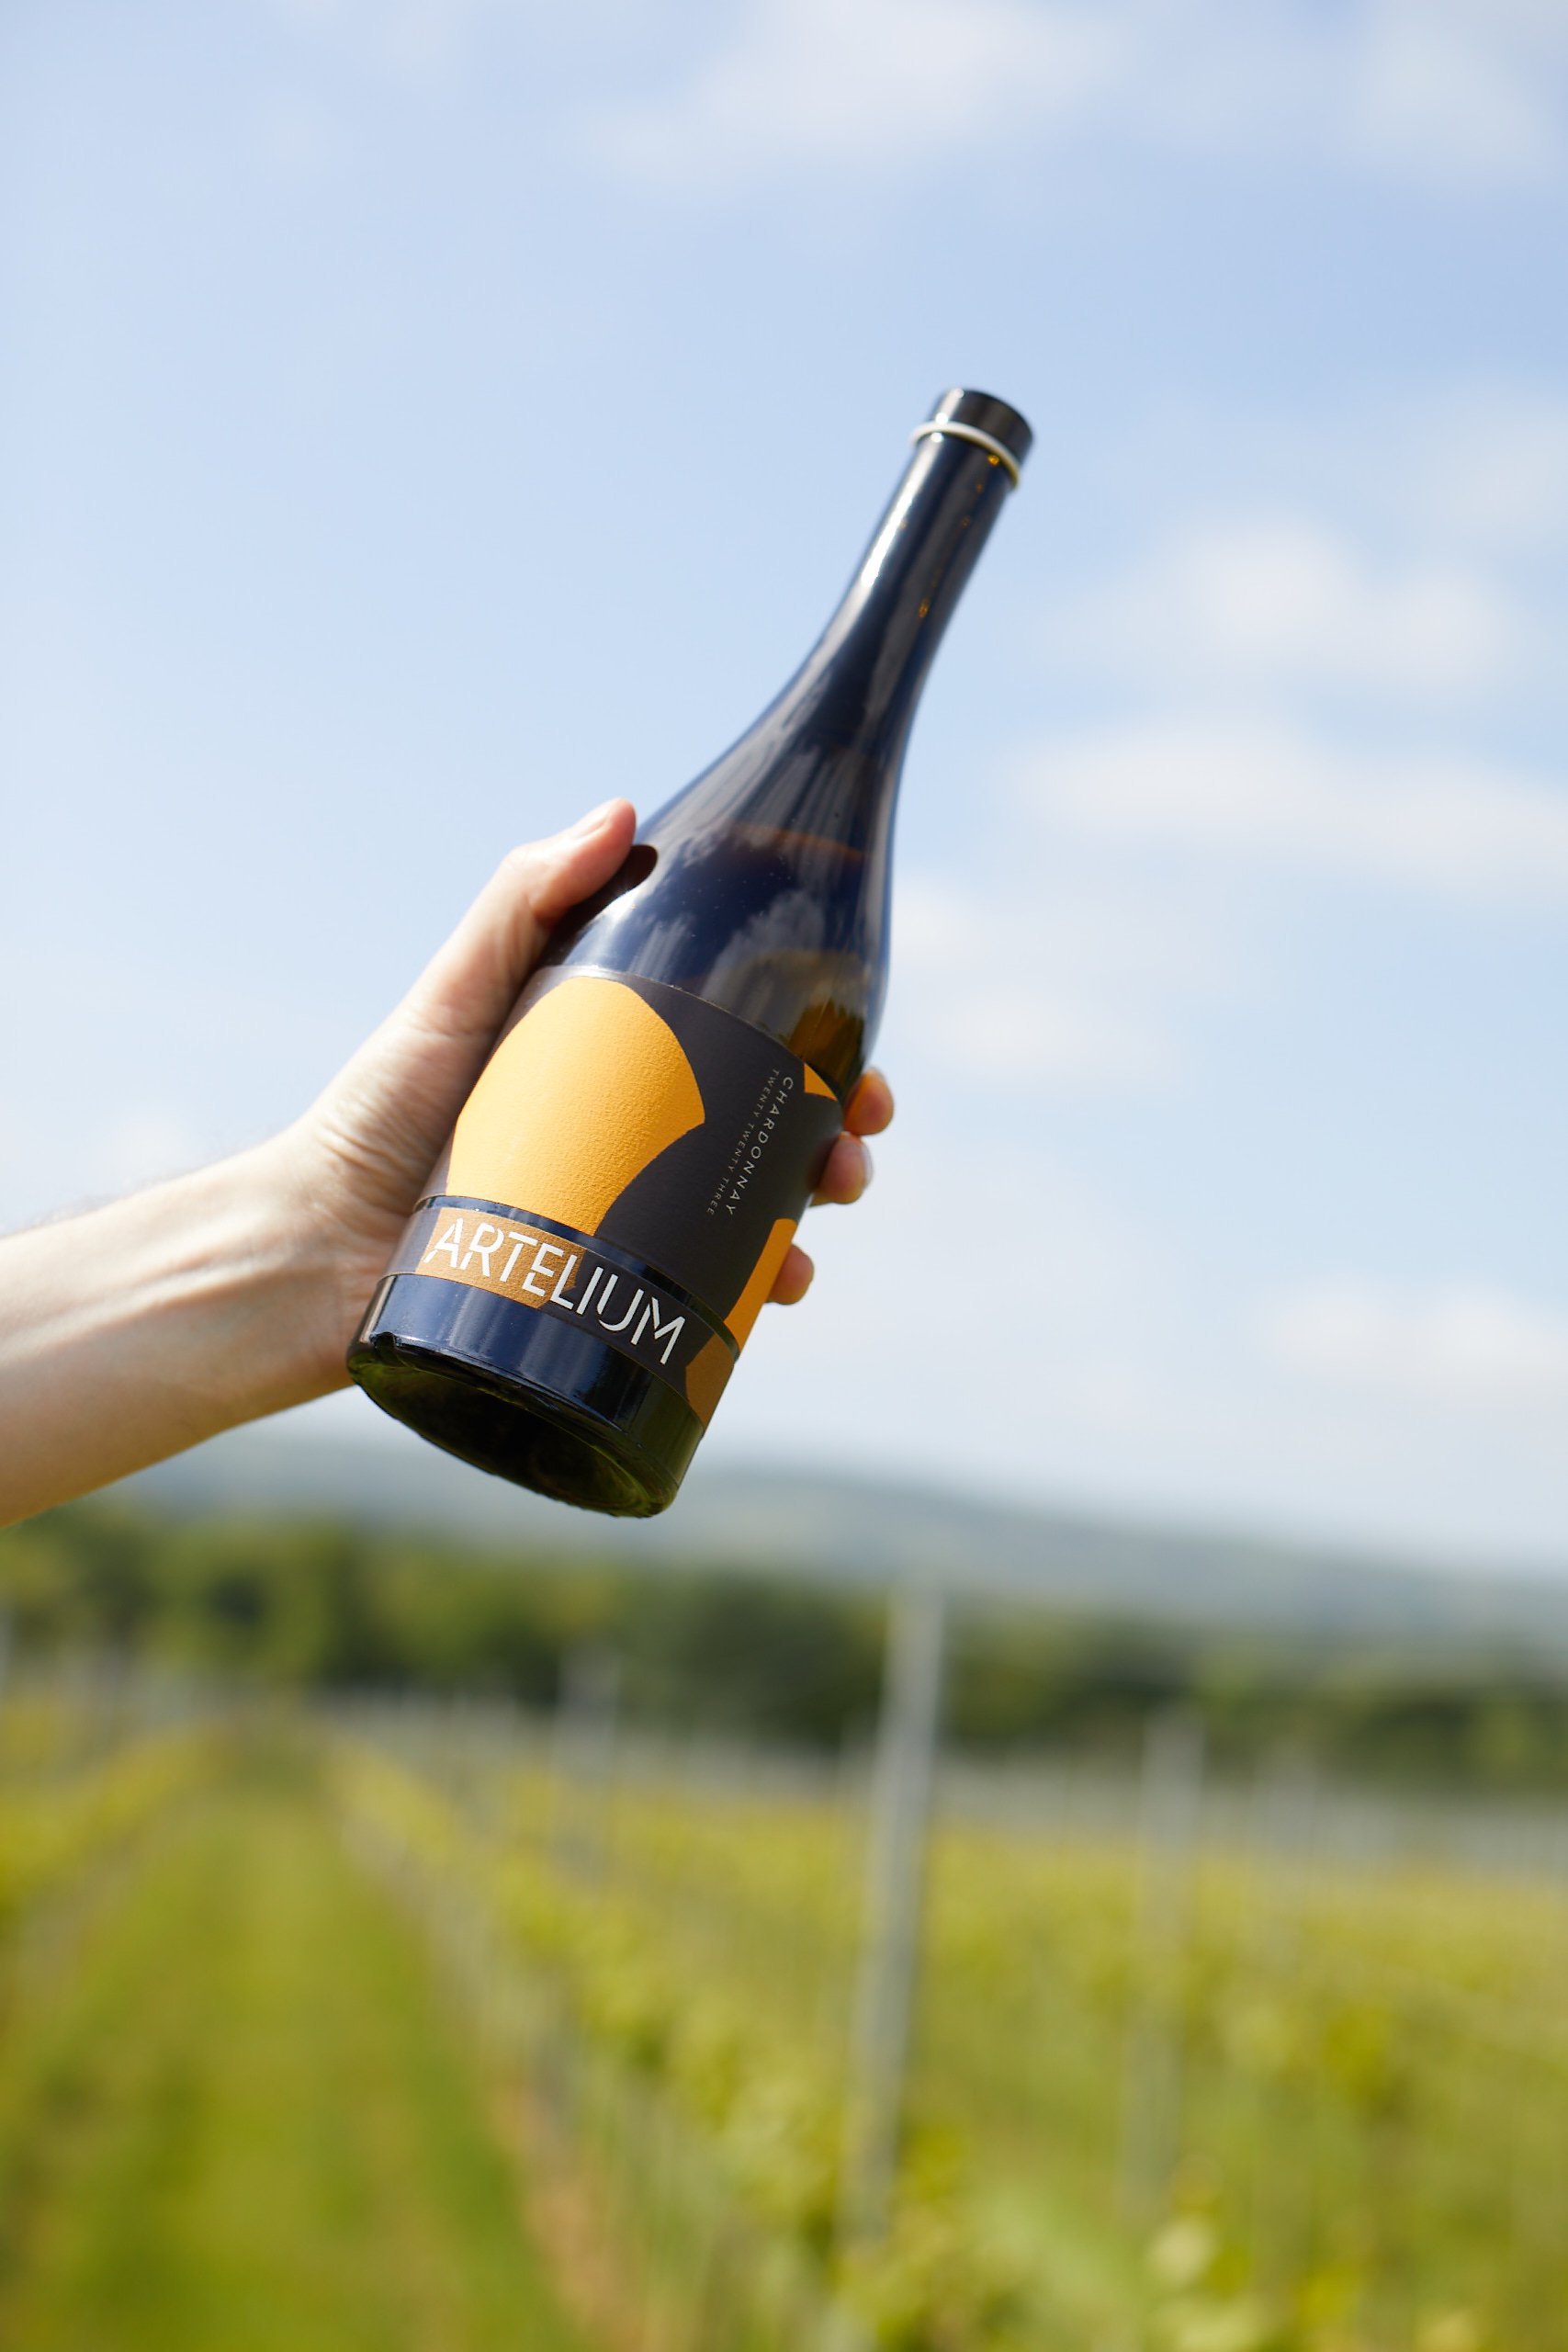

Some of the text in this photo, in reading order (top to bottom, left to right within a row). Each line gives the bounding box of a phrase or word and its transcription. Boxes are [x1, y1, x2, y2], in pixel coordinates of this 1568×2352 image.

[706, 1069, 780, 1216] TWENTY TWENTY THREE
[726, 1076, 794, 1216] CHARDONNAY
[423, 1217, 687, 1365] ARTELIUM
